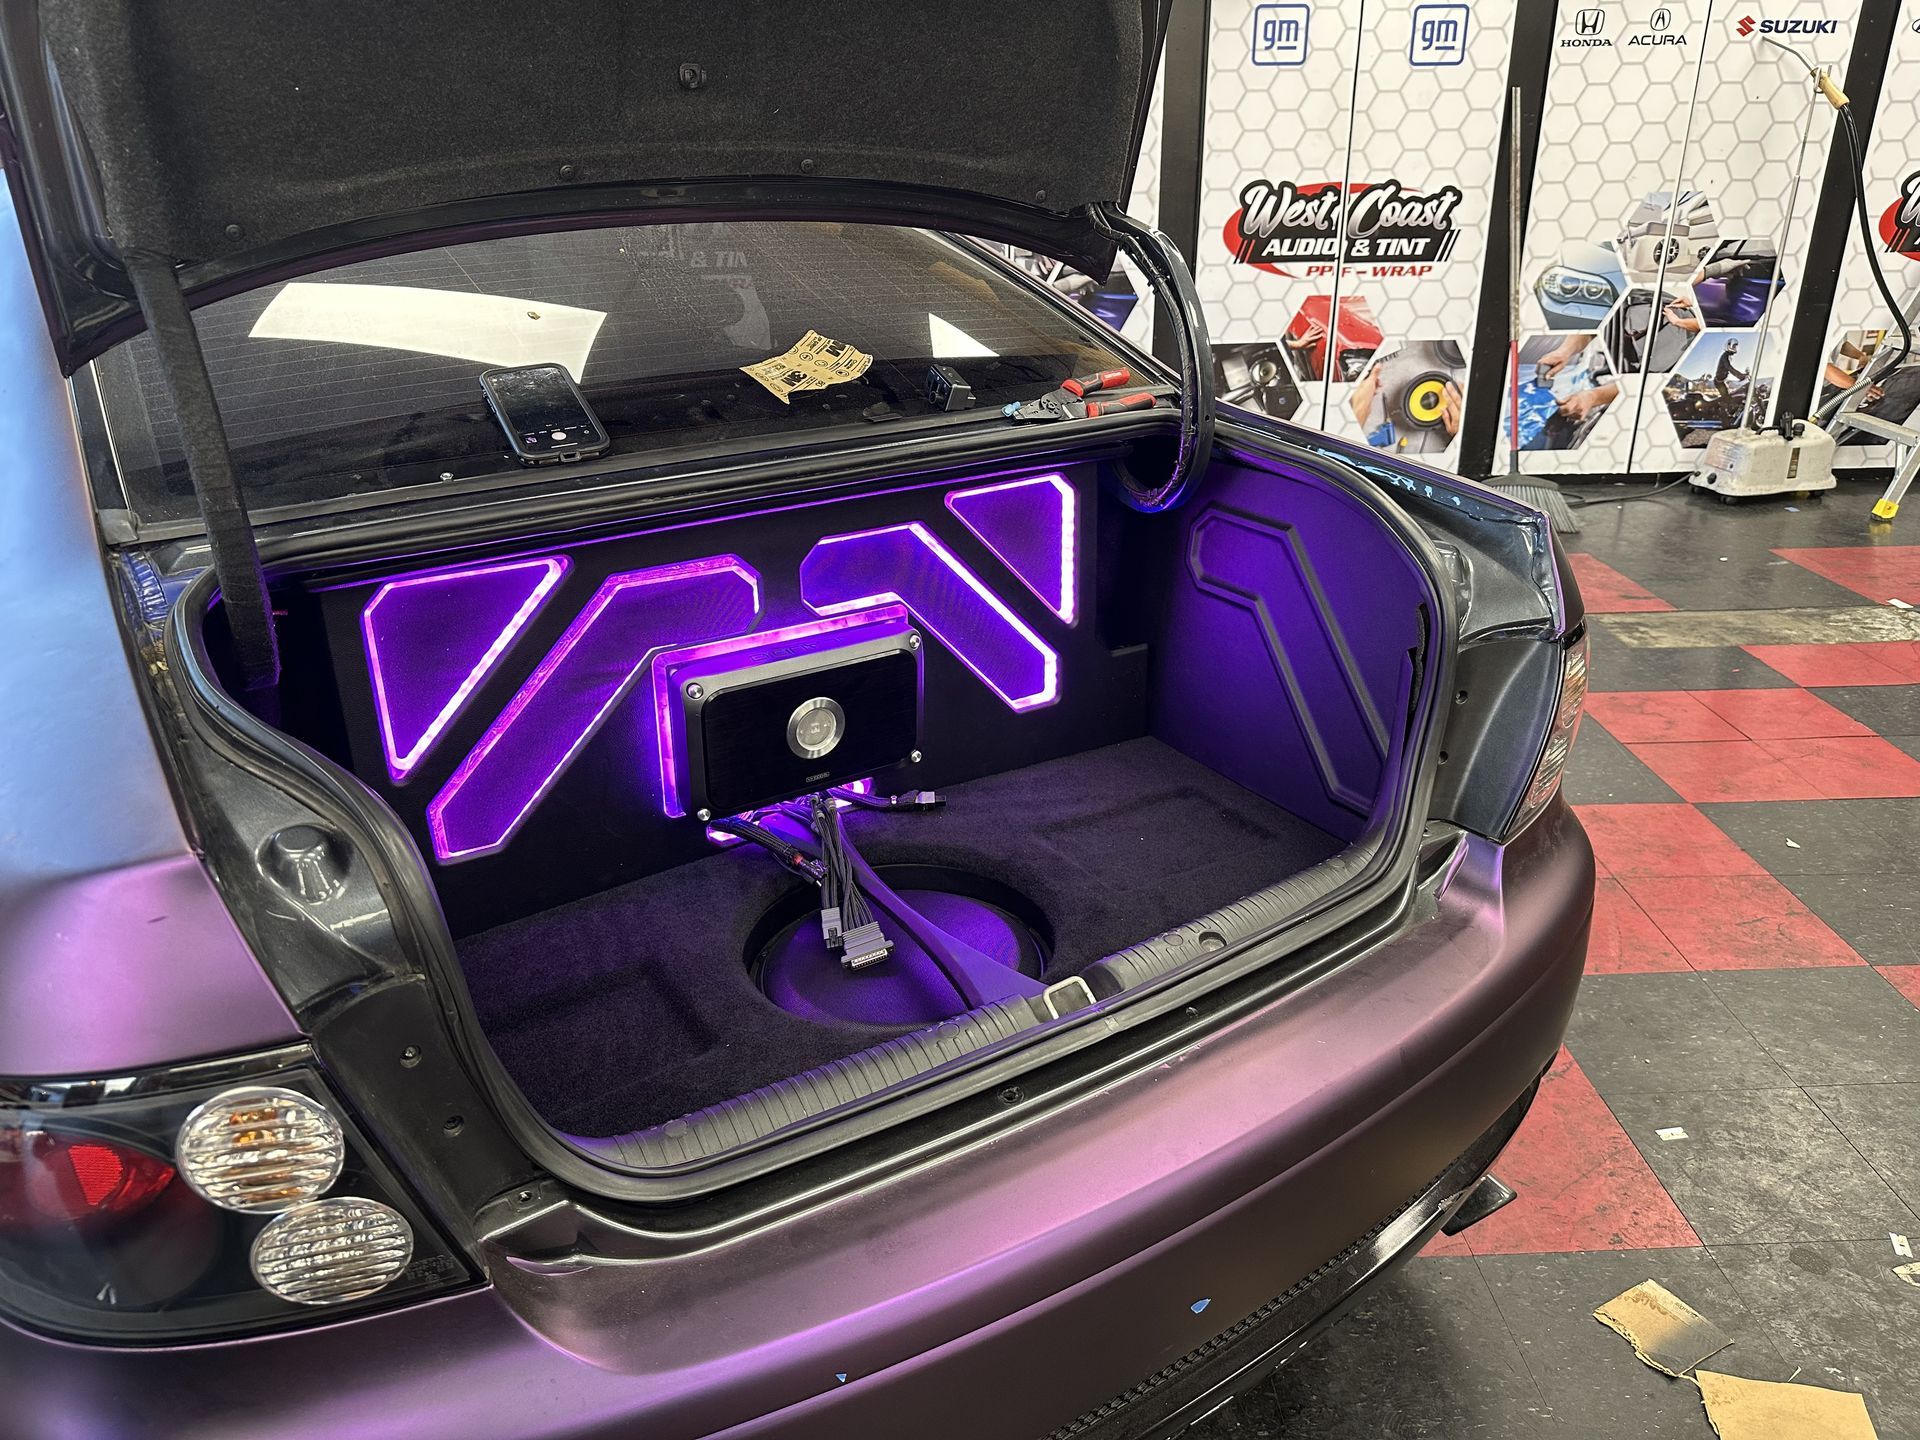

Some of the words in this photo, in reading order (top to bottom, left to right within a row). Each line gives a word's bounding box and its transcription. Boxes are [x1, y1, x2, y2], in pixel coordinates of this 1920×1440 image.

[1263, 20, 1299, 50] gm
[1421, 20, 1458, 50] gm
[1759, 20, 1838, 34] SUZUKI
[1560, 39, 1613, 47] HONDA
[1628, 35, 1688, 46] ACURA
[1244, 185, 1339, 238] West
[1347, 185, 1458, 239] Coast
[1261, 238, 1348, 257] AUDIO
[1350, 239, 1370, 257] &
[1376, 238, 1431, 256] TINT
[1372, 265, 1433, 277] WRAP
[781, 370, 808, 388] 3M
